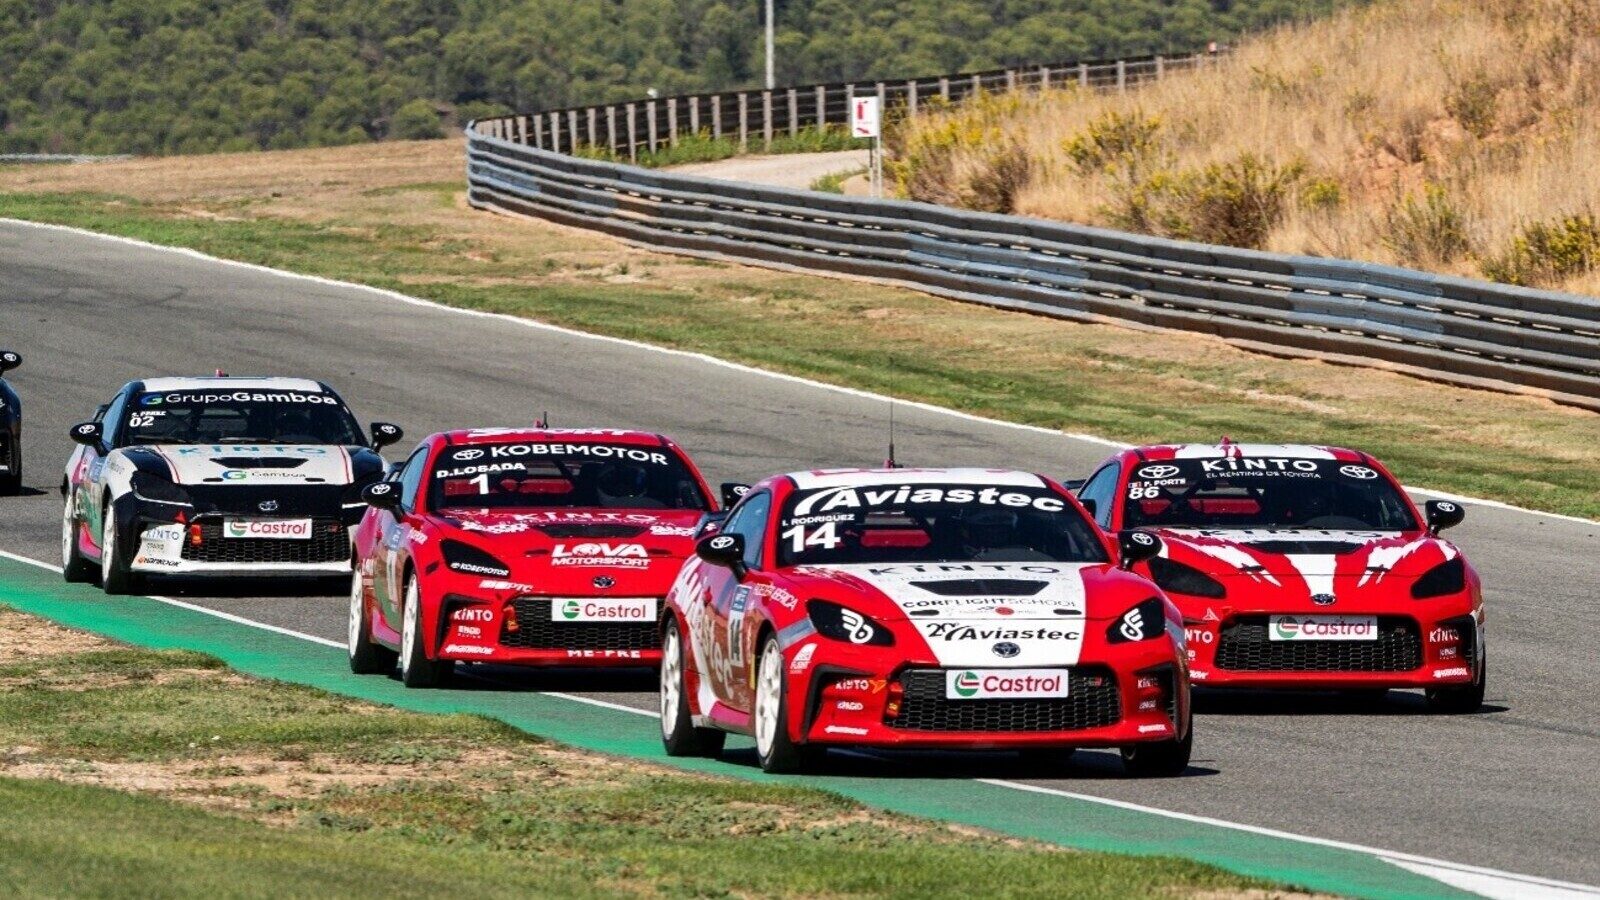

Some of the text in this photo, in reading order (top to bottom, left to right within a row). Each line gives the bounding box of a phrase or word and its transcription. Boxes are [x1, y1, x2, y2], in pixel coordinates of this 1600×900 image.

[165, 392, 338, 405] GrupoGamboa
[129, 415, 155, 427] 02
[491, 444, 668, 466] KOBEMOTOR
[436, 462, 526, 478] D.LOSADA
[469, 474, 490, 495] 1
[794, 485, 1065, 517] Aviastec
[1128, 486, 1159, 500] 86
[250, 522, 306, 535] Castrol
[782, 522, 841, 553] 14
[551, 543, 648, 558] LOVA
[551, 558, 651, 566] MOTORSPORT
[585, 602, 646, 618] Castrol
[945, 626, 1080, 641] Aviastec
[1302, 619, 1370, 635] Castrol
[983, 675, 1060, 692] Castrol
